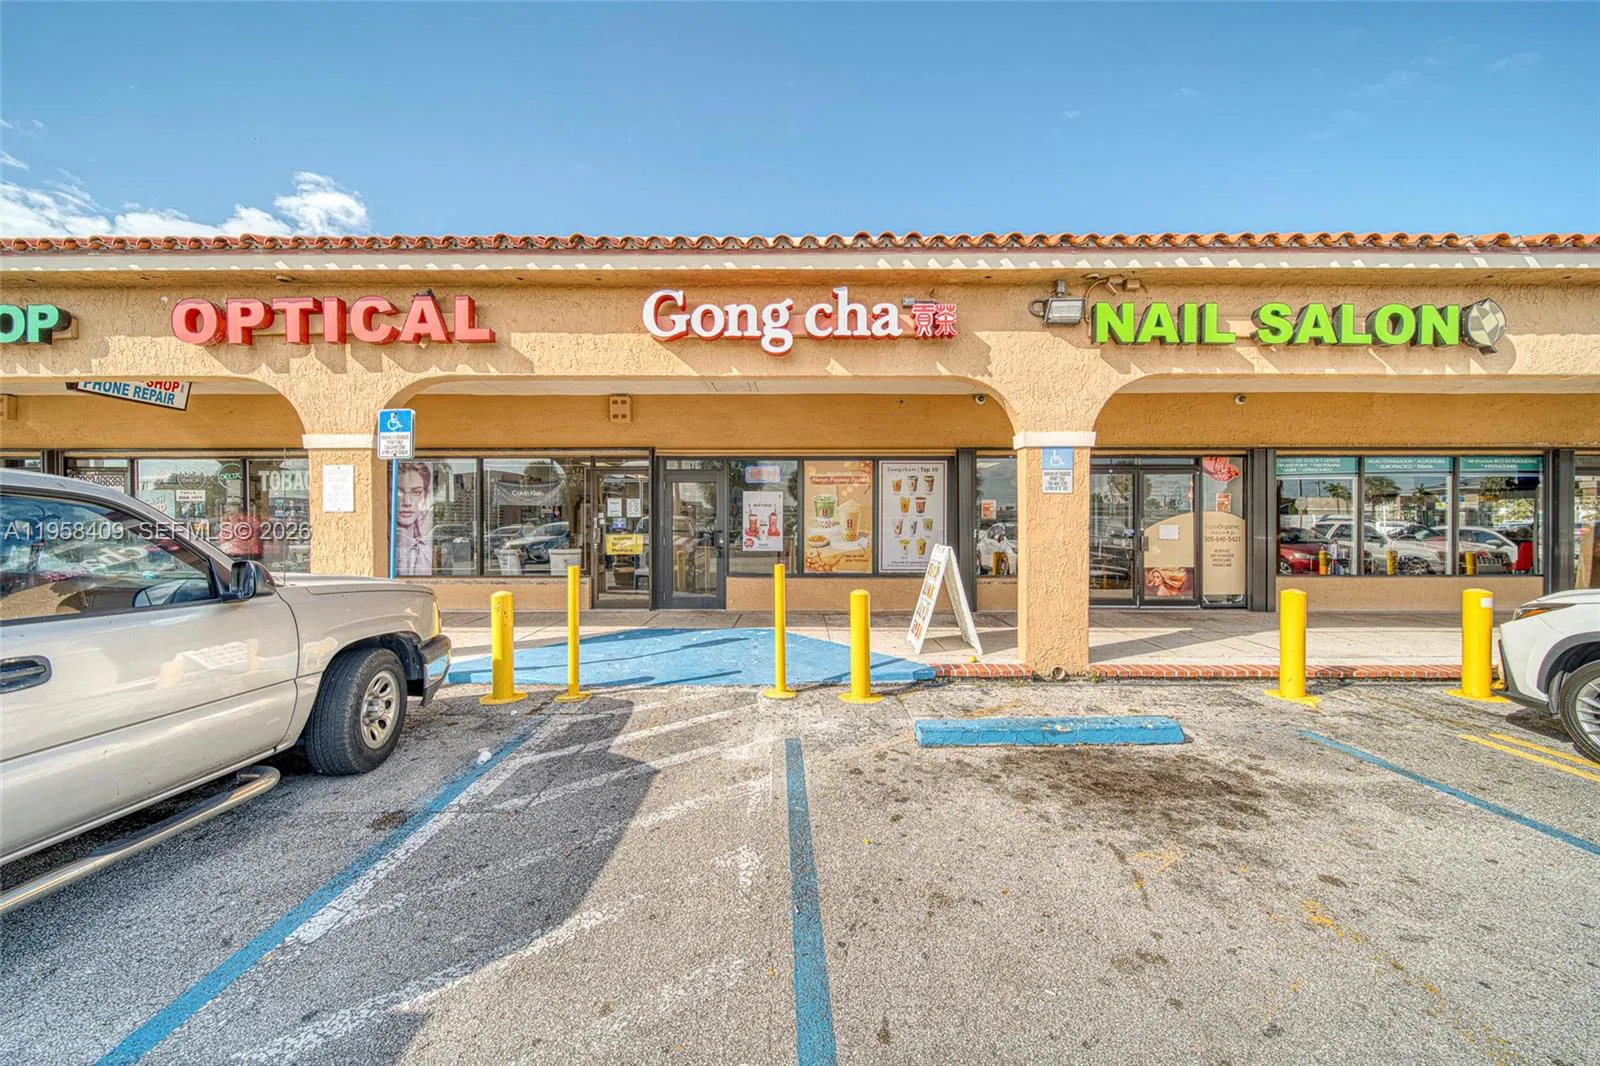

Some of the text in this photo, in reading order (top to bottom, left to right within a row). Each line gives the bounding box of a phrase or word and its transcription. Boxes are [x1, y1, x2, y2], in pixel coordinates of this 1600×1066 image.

[171, 295, 495, 346] OPTICAL
[642, 286, 903, 356] Gong cha
[1092, 301, 1460, 346] NAIL SALON
[83, 381, 175, 405] PHONE REPAIR
